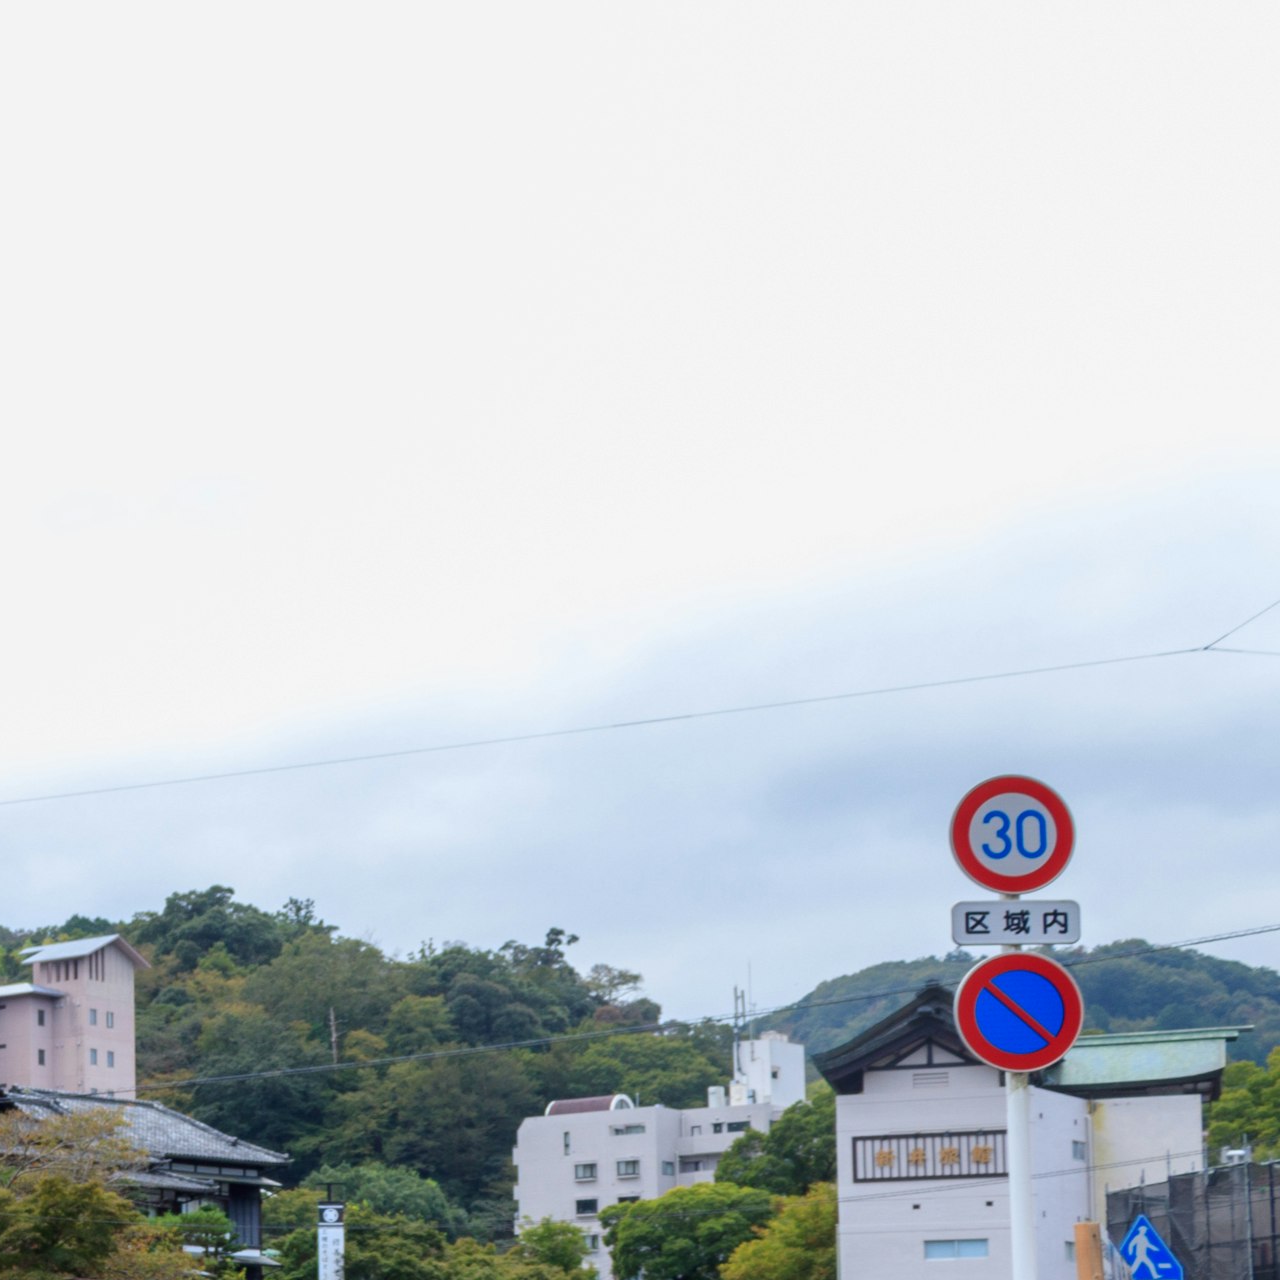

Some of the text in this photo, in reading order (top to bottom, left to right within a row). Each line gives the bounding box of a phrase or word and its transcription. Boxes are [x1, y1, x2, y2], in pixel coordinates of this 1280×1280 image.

[981, 809, 1047, 860] 30
[964, 909, 1069, 935] 区域内
[875, 1146, 992, 1168] 新井旅館
